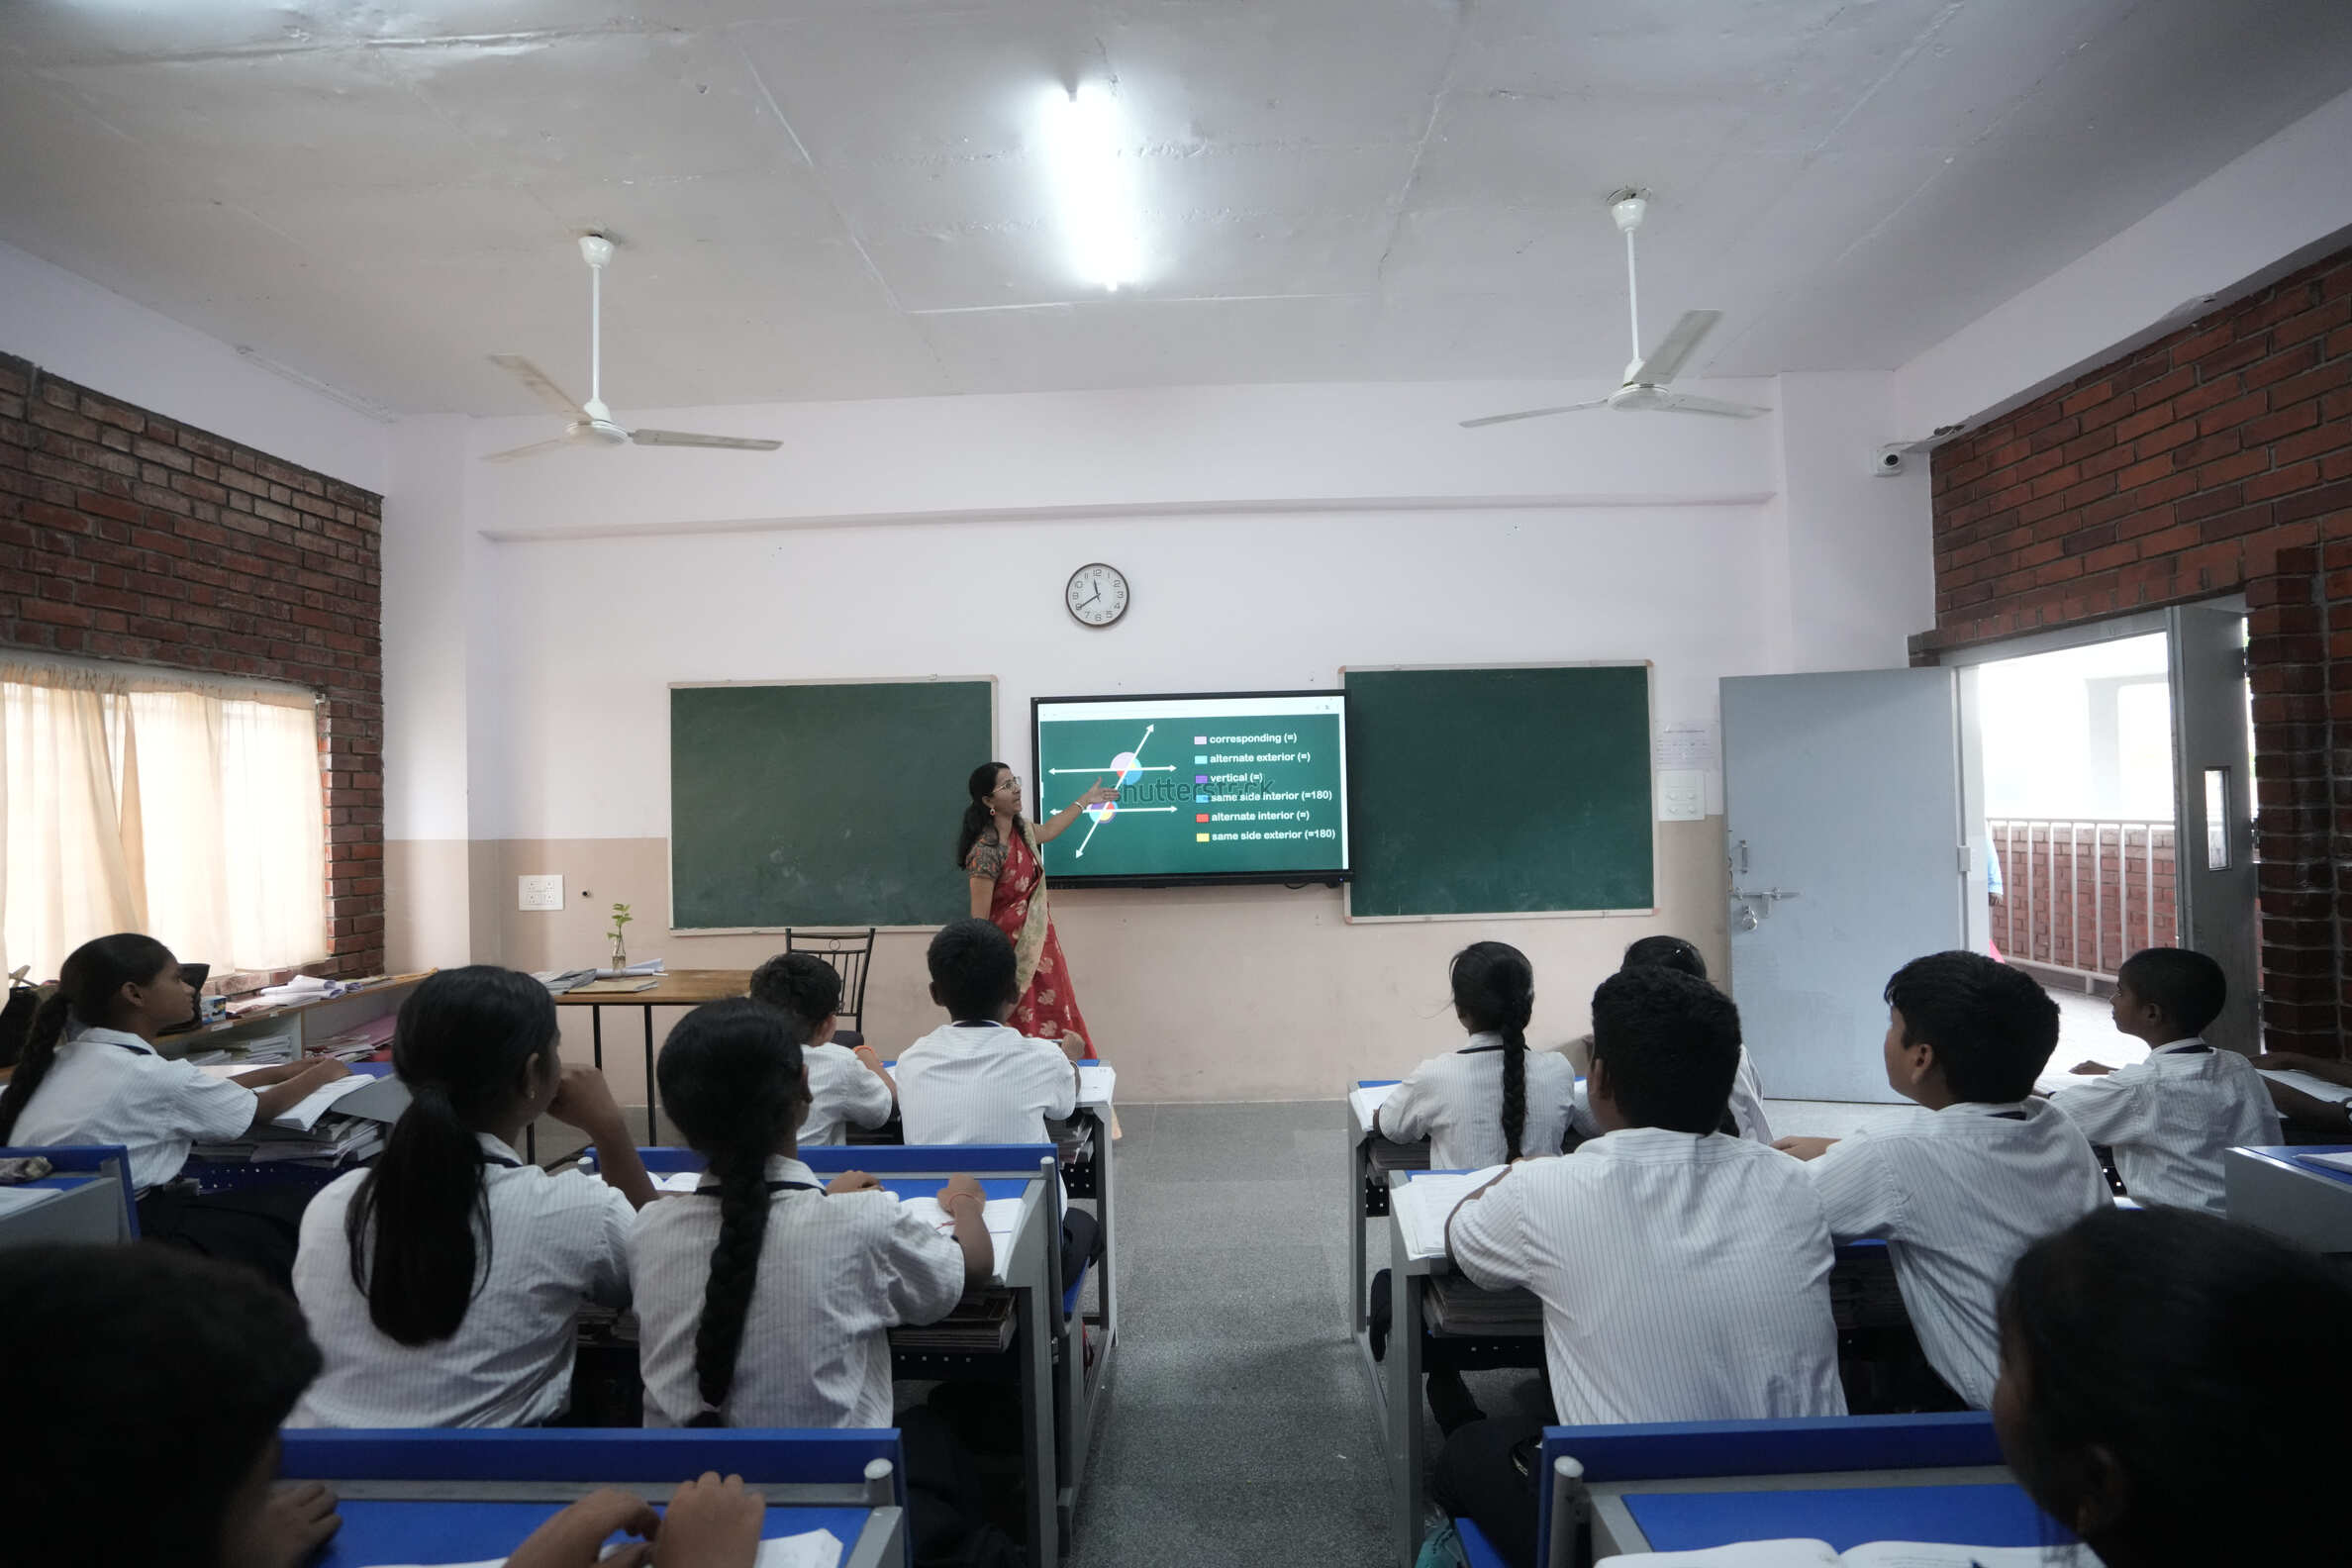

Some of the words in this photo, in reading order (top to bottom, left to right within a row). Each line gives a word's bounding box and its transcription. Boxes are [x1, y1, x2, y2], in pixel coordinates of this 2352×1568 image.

[1210, 734, 1281, 744] corresponding
[1284, 733, 1297, 744] (=)
[1211, 754, 1254, 763] alternate
[1256, 752, 1295, 761] exterior
[1298, 752, 1311, 763] (=)
[1211, 773, 1247, 782] vertical
[1250, 773, 1262, 784] (=)
[1240, 792, 1260, 801] side
[1302, 791, 1331, 802] (=180)
[1212, 812, 1256, 821] alternate
[1258, 811, 1294, 820] interior
[1297, 811, 1310, 822] (=)
[1264, 831, 1302, 839] exterior
[1305, 830, 1335, 840] (=180)
